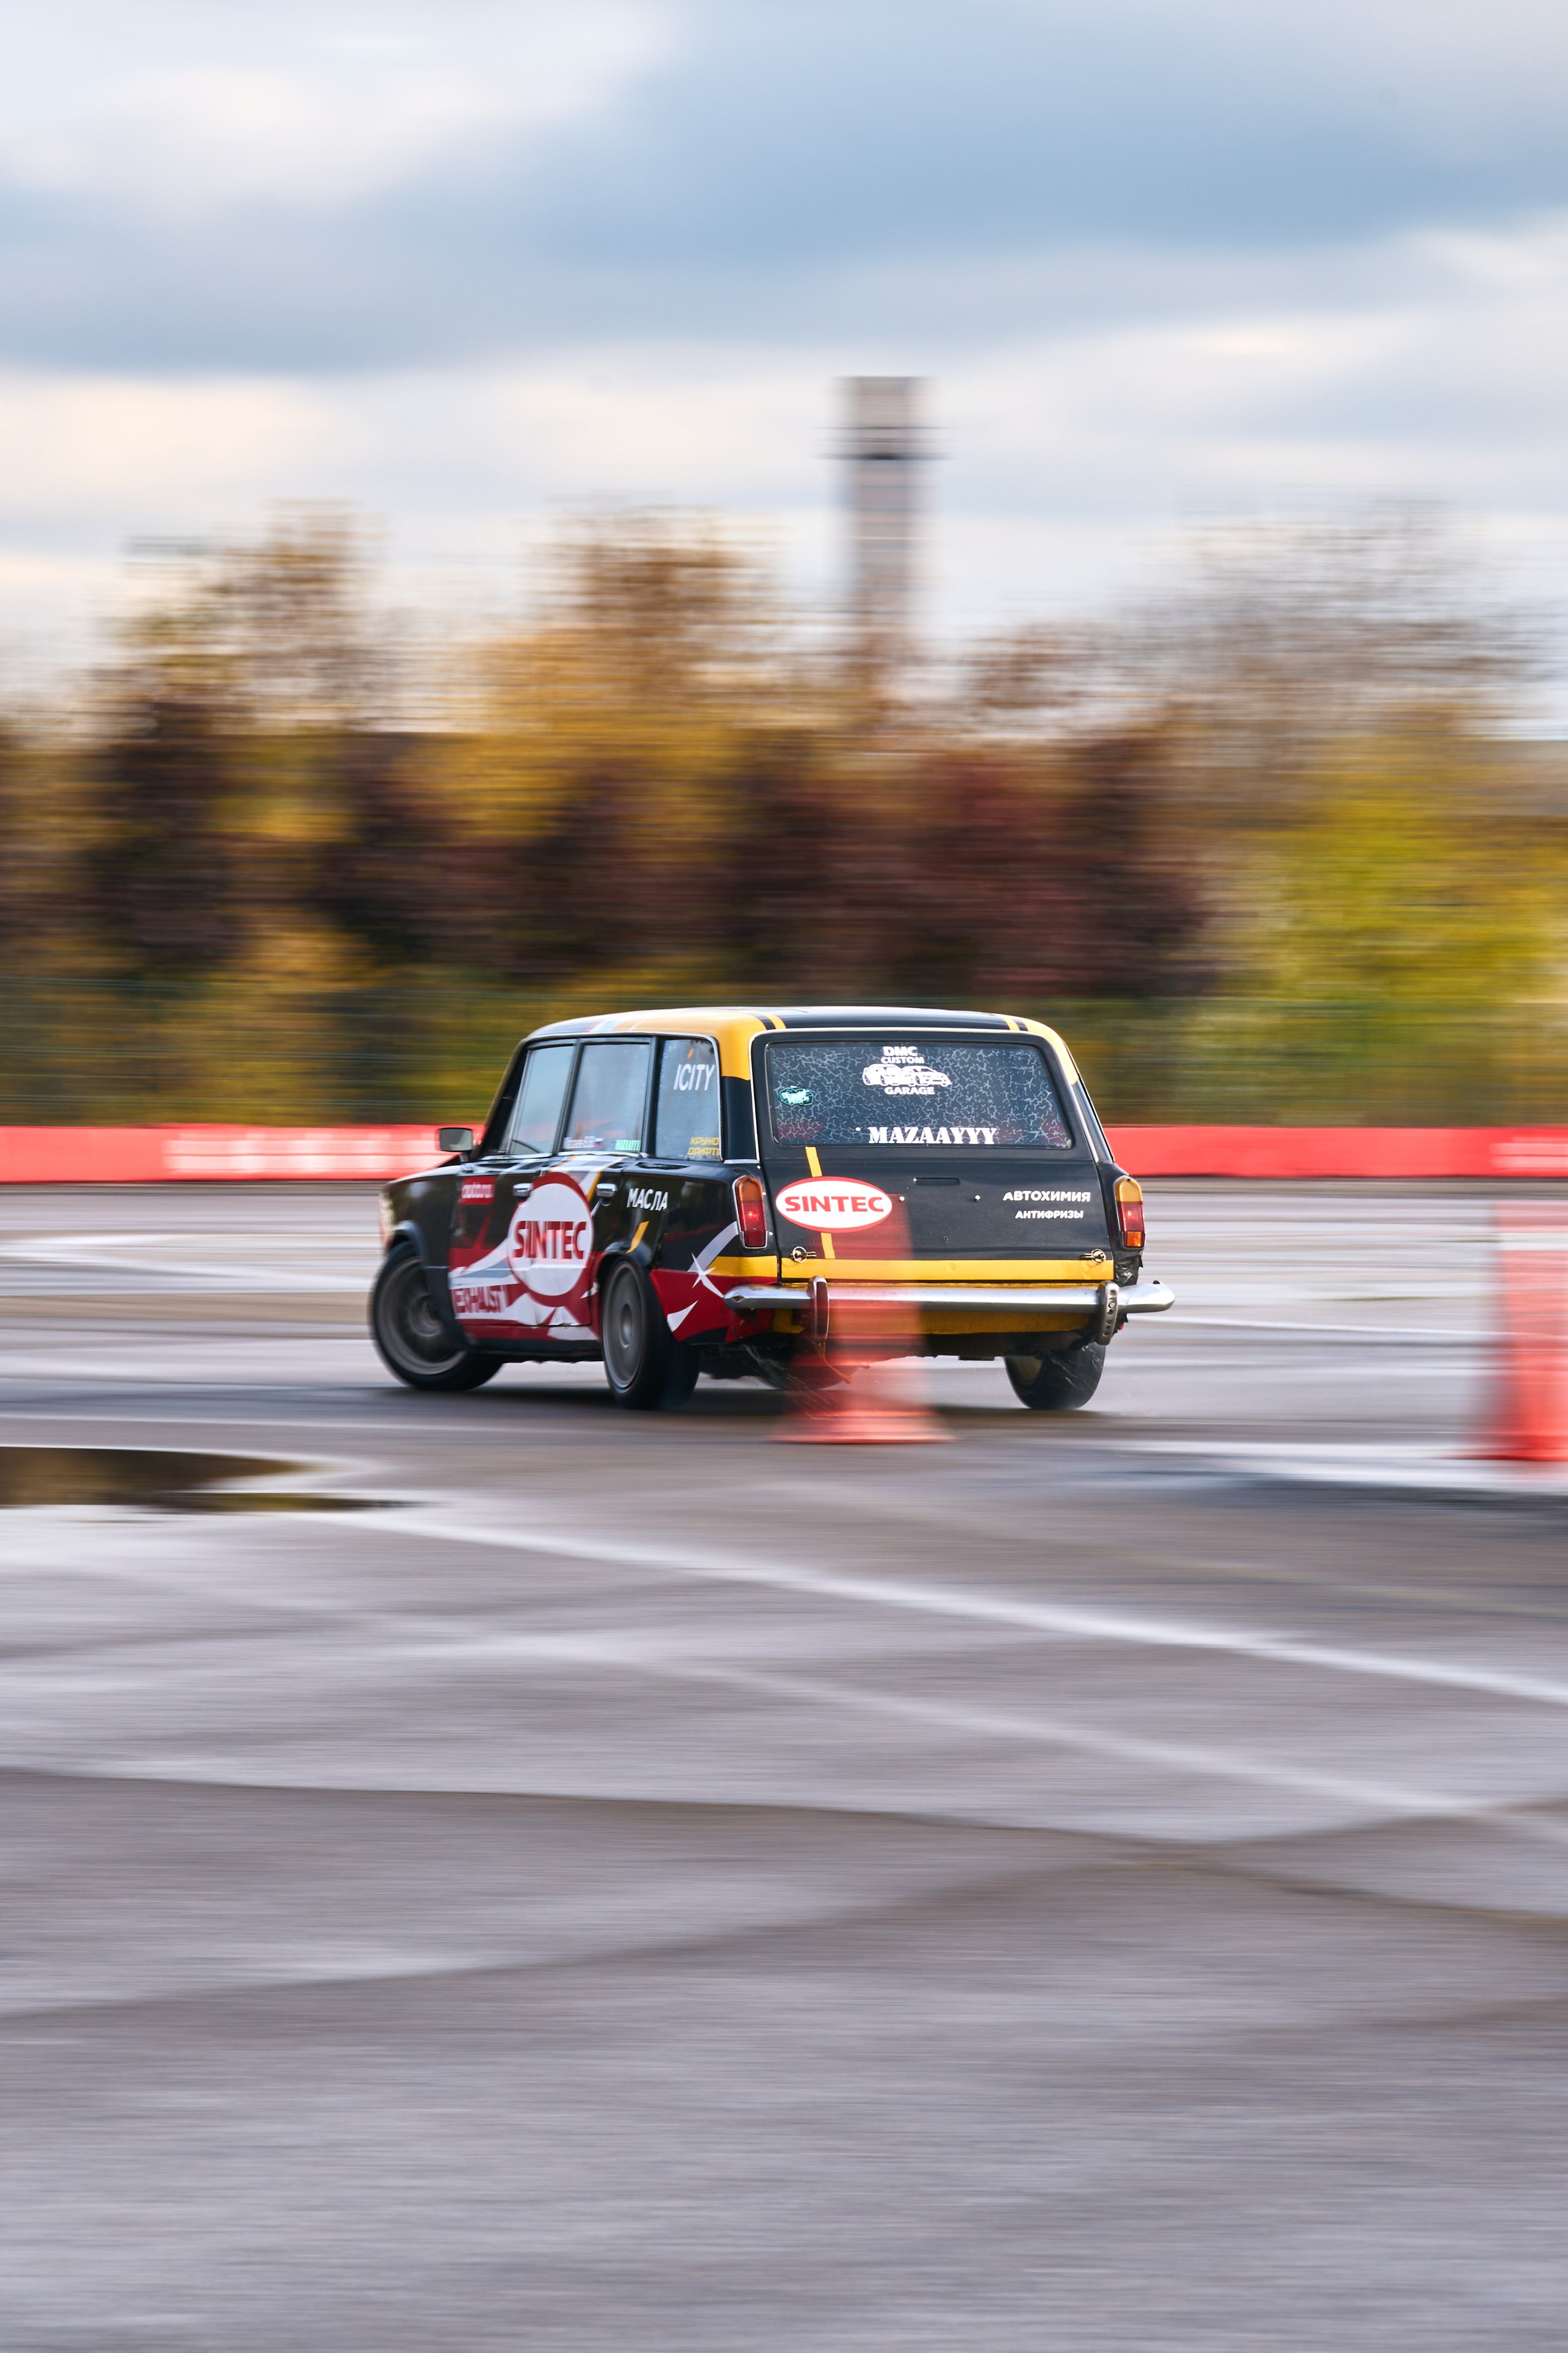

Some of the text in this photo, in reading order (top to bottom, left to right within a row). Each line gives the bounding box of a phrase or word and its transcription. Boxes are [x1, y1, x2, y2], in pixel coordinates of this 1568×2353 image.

[883, 1046, 918, 1057] DMC
[673, 1063, 715, 1091] ICITY
[884, 1086, 935, 1095] GARAGE
[867, 1127, 998, 1145] MAZAAYYY
[627, 1188, 669, 1211] МАСЛА
[785, 1196, 884, 1212] SINTEC
[1003, 1190, 1091, 1202] АВТОХИМИЯ
[1015, 1210, 1084, 1219] АНТИФРИЗЫ
[513, 1220, 587, 1260] SINTEC
